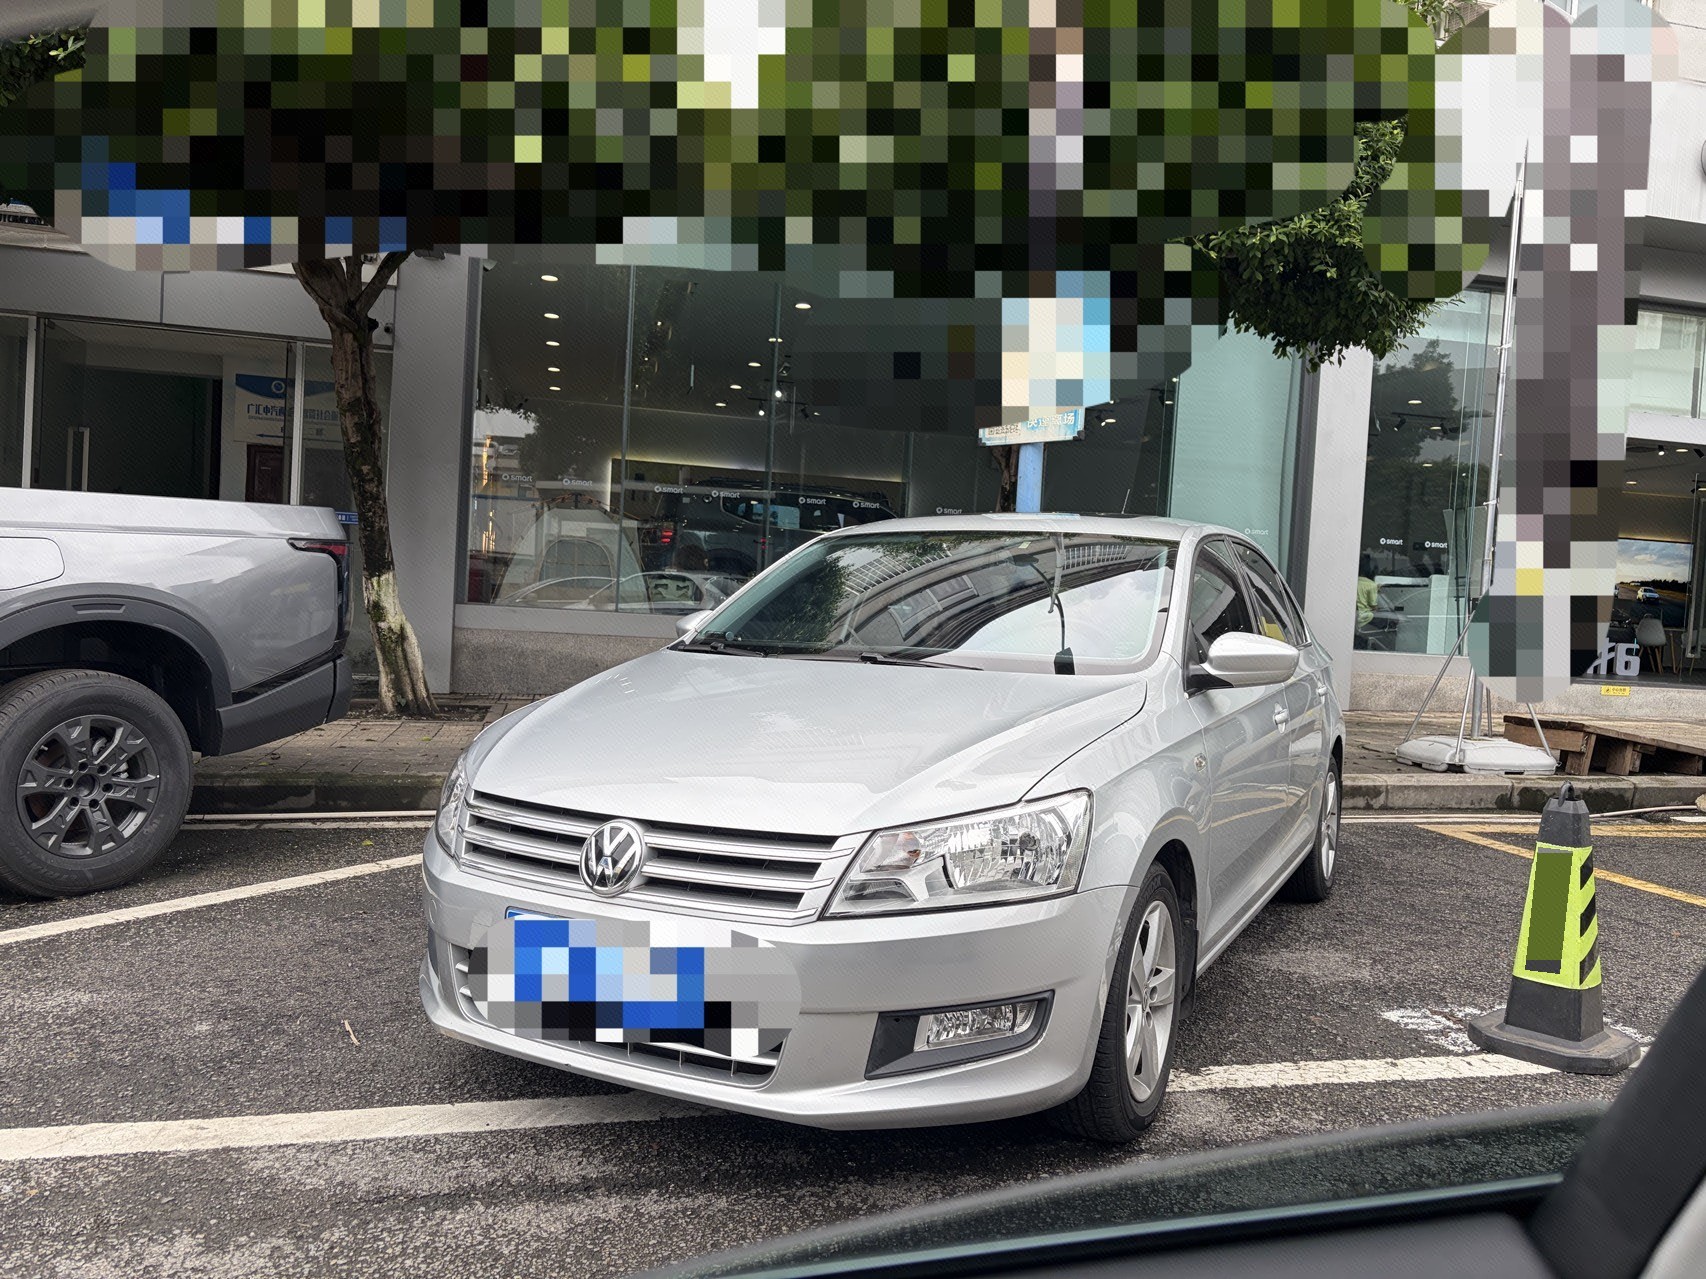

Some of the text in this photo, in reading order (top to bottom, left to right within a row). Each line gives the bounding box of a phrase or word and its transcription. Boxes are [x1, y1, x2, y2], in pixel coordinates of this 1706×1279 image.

[511, 474, 533, 482] smart
[571, 479, 593, 487] smart
[860, 501, 880, 509] smart
